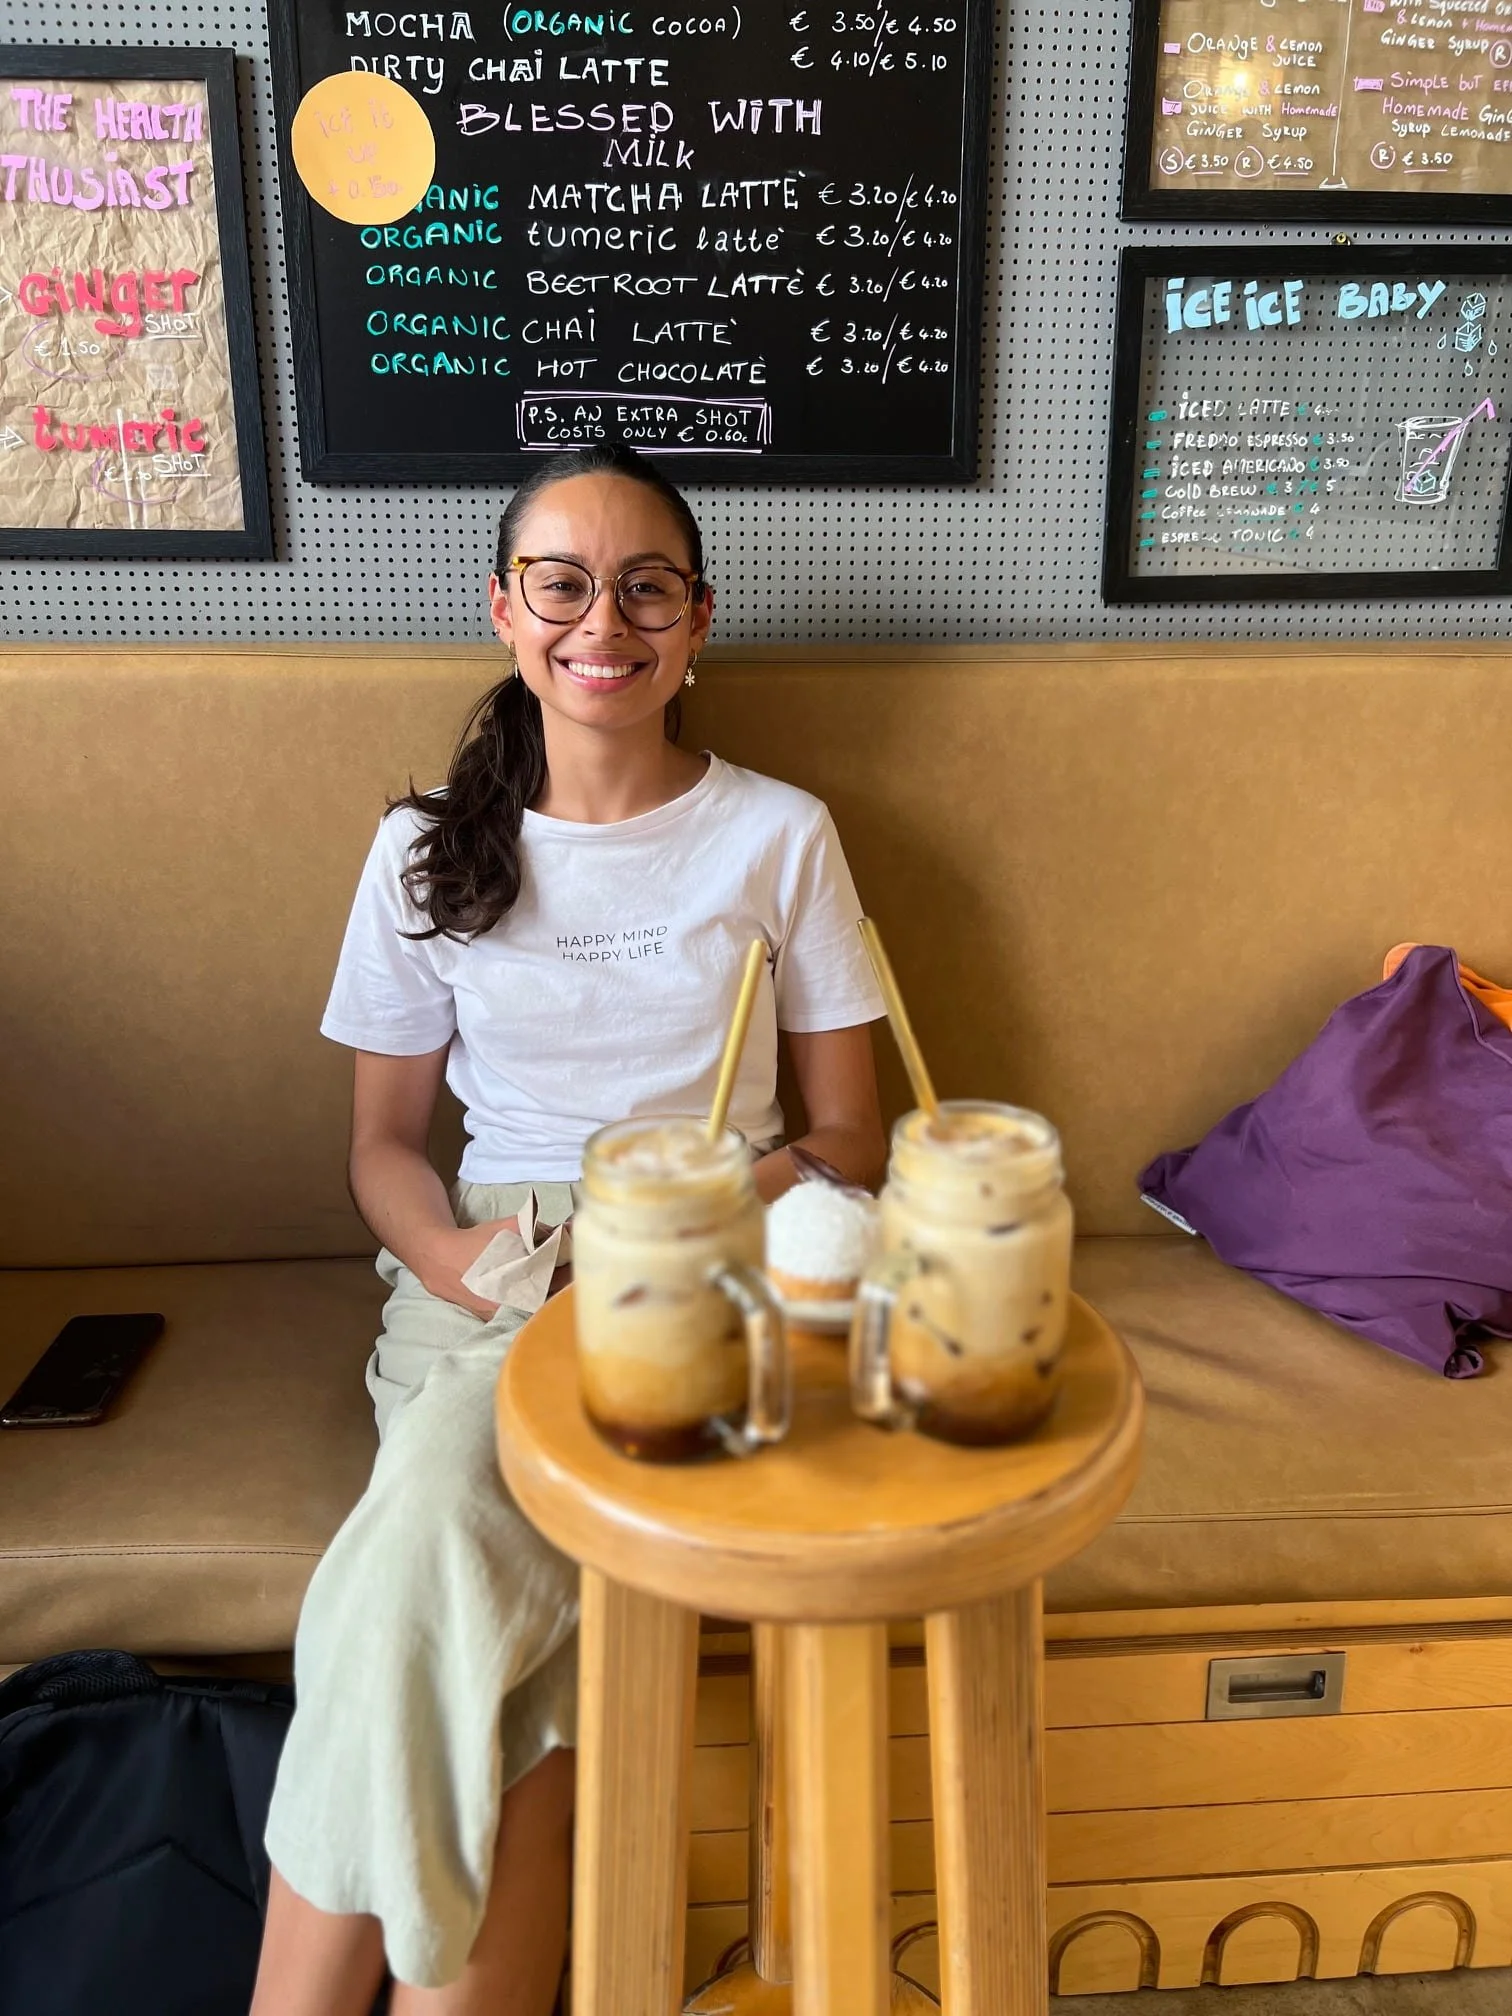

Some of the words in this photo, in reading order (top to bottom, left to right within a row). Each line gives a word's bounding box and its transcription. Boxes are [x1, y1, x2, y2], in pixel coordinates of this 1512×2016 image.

[346, 11, 477, 43] MOCHA
[652, 6, 741, 40] COCOA)
[789, 11, 810, 32] €
[908, 17, 957, 33] 4.50
[1396, 9, 1407, 25] &
[1265, 35, 1276, 52] &
[559, 57, 669, 86] LATTE
[790, 46, 814, 69] €
[905, 52, 948, 71] 5.10
[1272, 53, 1316, 68] JUICE
[1259, 80, 1270, 96] &
[11, 87, 73, 132] THE
[94, 97, 204, 143] HEALTH
[456, 101, 674, 136] BLESSED
[1190, 104, 1228, 117] JUICE
[1185, 154, 1196, 169] €
[1201, 154, 1229, 168] 3.50
[1267, 154, 1280, 169] €
[1283, 156, 1313, 170] 4.50
[1402, 152, 1414, 166] €
[1421, 152, 1453, 165] 3.50
[413, 183, 499, 214] ANiC
[528, 179, 683, 216] MATCHA
[818, 182, 843, 205] €
[923, 184, 958, 205] 4.20
[528, 222, 676, 254] tumeric
[815, 225, 836, 246] €
[923, 228, 953, 247] 4.20
[366, 264, 498, 290] ORGANIC
[815, 273, 836, 296] €
[921, 275, 949, 290] 4.20
[1337, 279, 1447, 320] BABY
[366, 310, 511, 340] ORGANIC
[811, 320, 831, 343] €
[918, 326, 948, 341] 4.20
[34, 342, 50, 357] €
[60, 337, 101, 357] 1.50
[371, 352, 511, 377] ORGANIC
[537, 357, 598, 379] HOT
[806, 357, 824, 376] €
[918, 359, 949, 374] 4.20
[528, 404, 565, 425] P.S.
[574, 404, 602, 422] AN
[617, 406, 678, 422] EXTRA
[695, 408, 752, 427] SHOT
[1238, 398, 1291, 417] LATTE
[547, 425, 606, 439] COSTS
[623, 427, 667, 440] ONLY
[677, 426, 696, 443] €
[1246, 433, 1308, 448] ESPRESSO
[1326, 433, 1355, 444] 3.50
[1323, 457, 1350, 470] 3.50
[1209, 483, 1257, 499] BREW
[1284, 480, 1293, 493] 3
[1326, 479, 1337, 492] 5
[1309, 502, 1321, 515] 4
[1231, 529, 1284, 542] TONIC
[557, 933, 616, 949] HAPPY
[623, 925, 668, 943] MIND
[562, 949, 622, 962] HAPPY
[629, 941, 664, 959] LIFE
